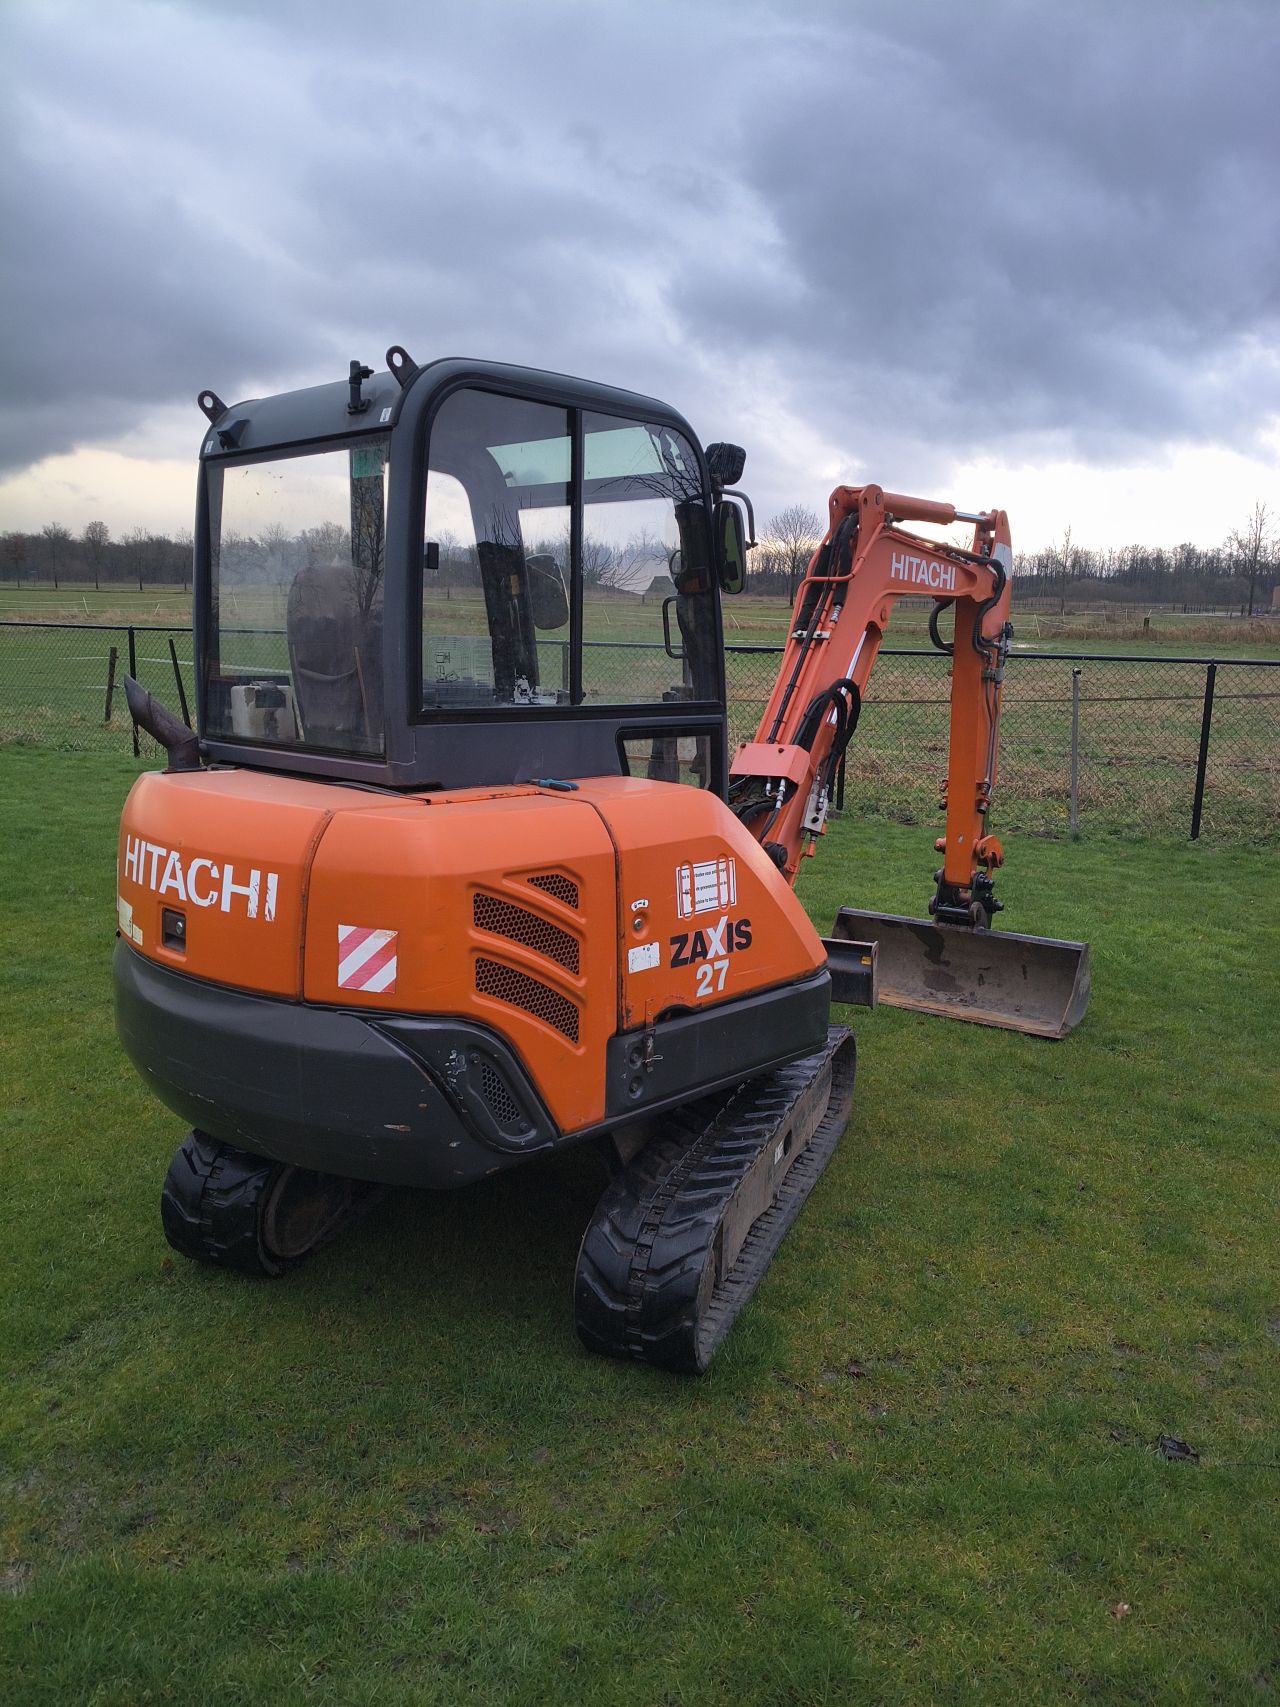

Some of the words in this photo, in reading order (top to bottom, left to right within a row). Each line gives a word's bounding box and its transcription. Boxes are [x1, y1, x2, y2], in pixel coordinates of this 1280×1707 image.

[890, 552, 955, 590] HITACHI
[125, 834, 279, 922] HITACHI
[670, 916, 752, 968] ZAXIS
[696, 959, 729, 997] 27
